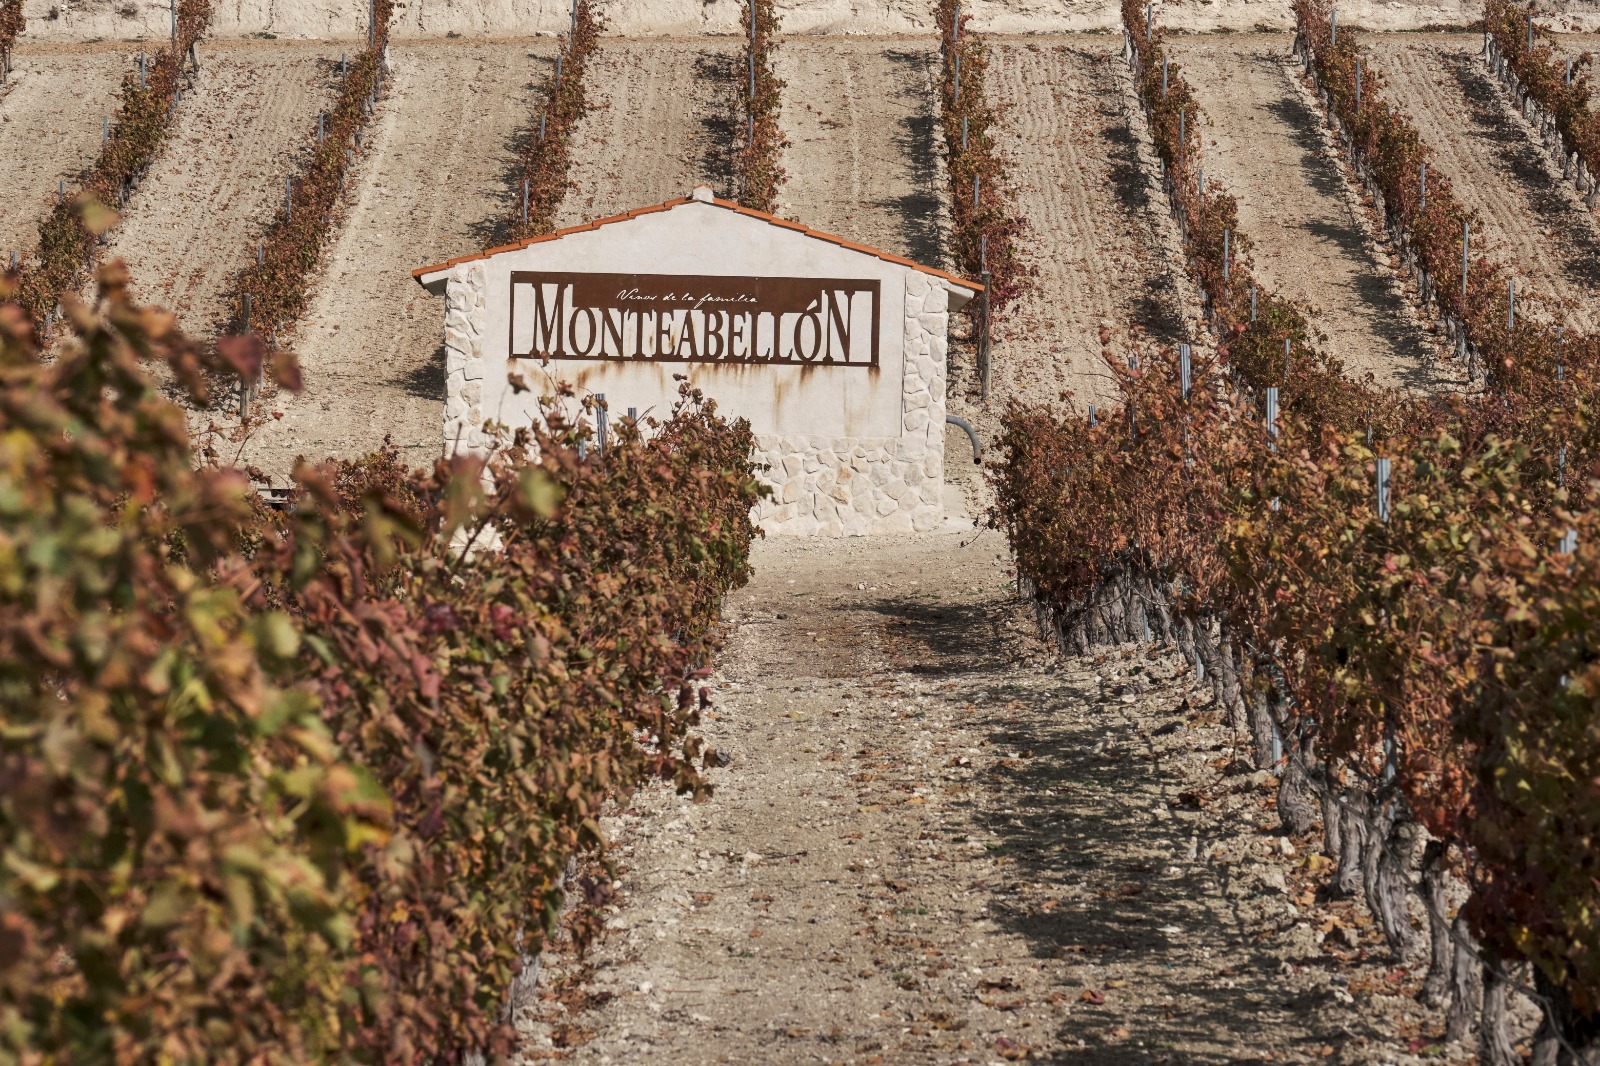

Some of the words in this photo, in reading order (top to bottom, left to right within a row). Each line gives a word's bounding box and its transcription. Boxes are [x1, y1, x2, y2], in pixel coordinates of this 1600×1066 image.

[529, 283, 856, 362] MONTEABELLÓN
[616, 288, 658, 301] Vinos
[662, 292, 677, 301] de
[681, 292, 696, 301] la
[693, 292, 758, 310] familia
